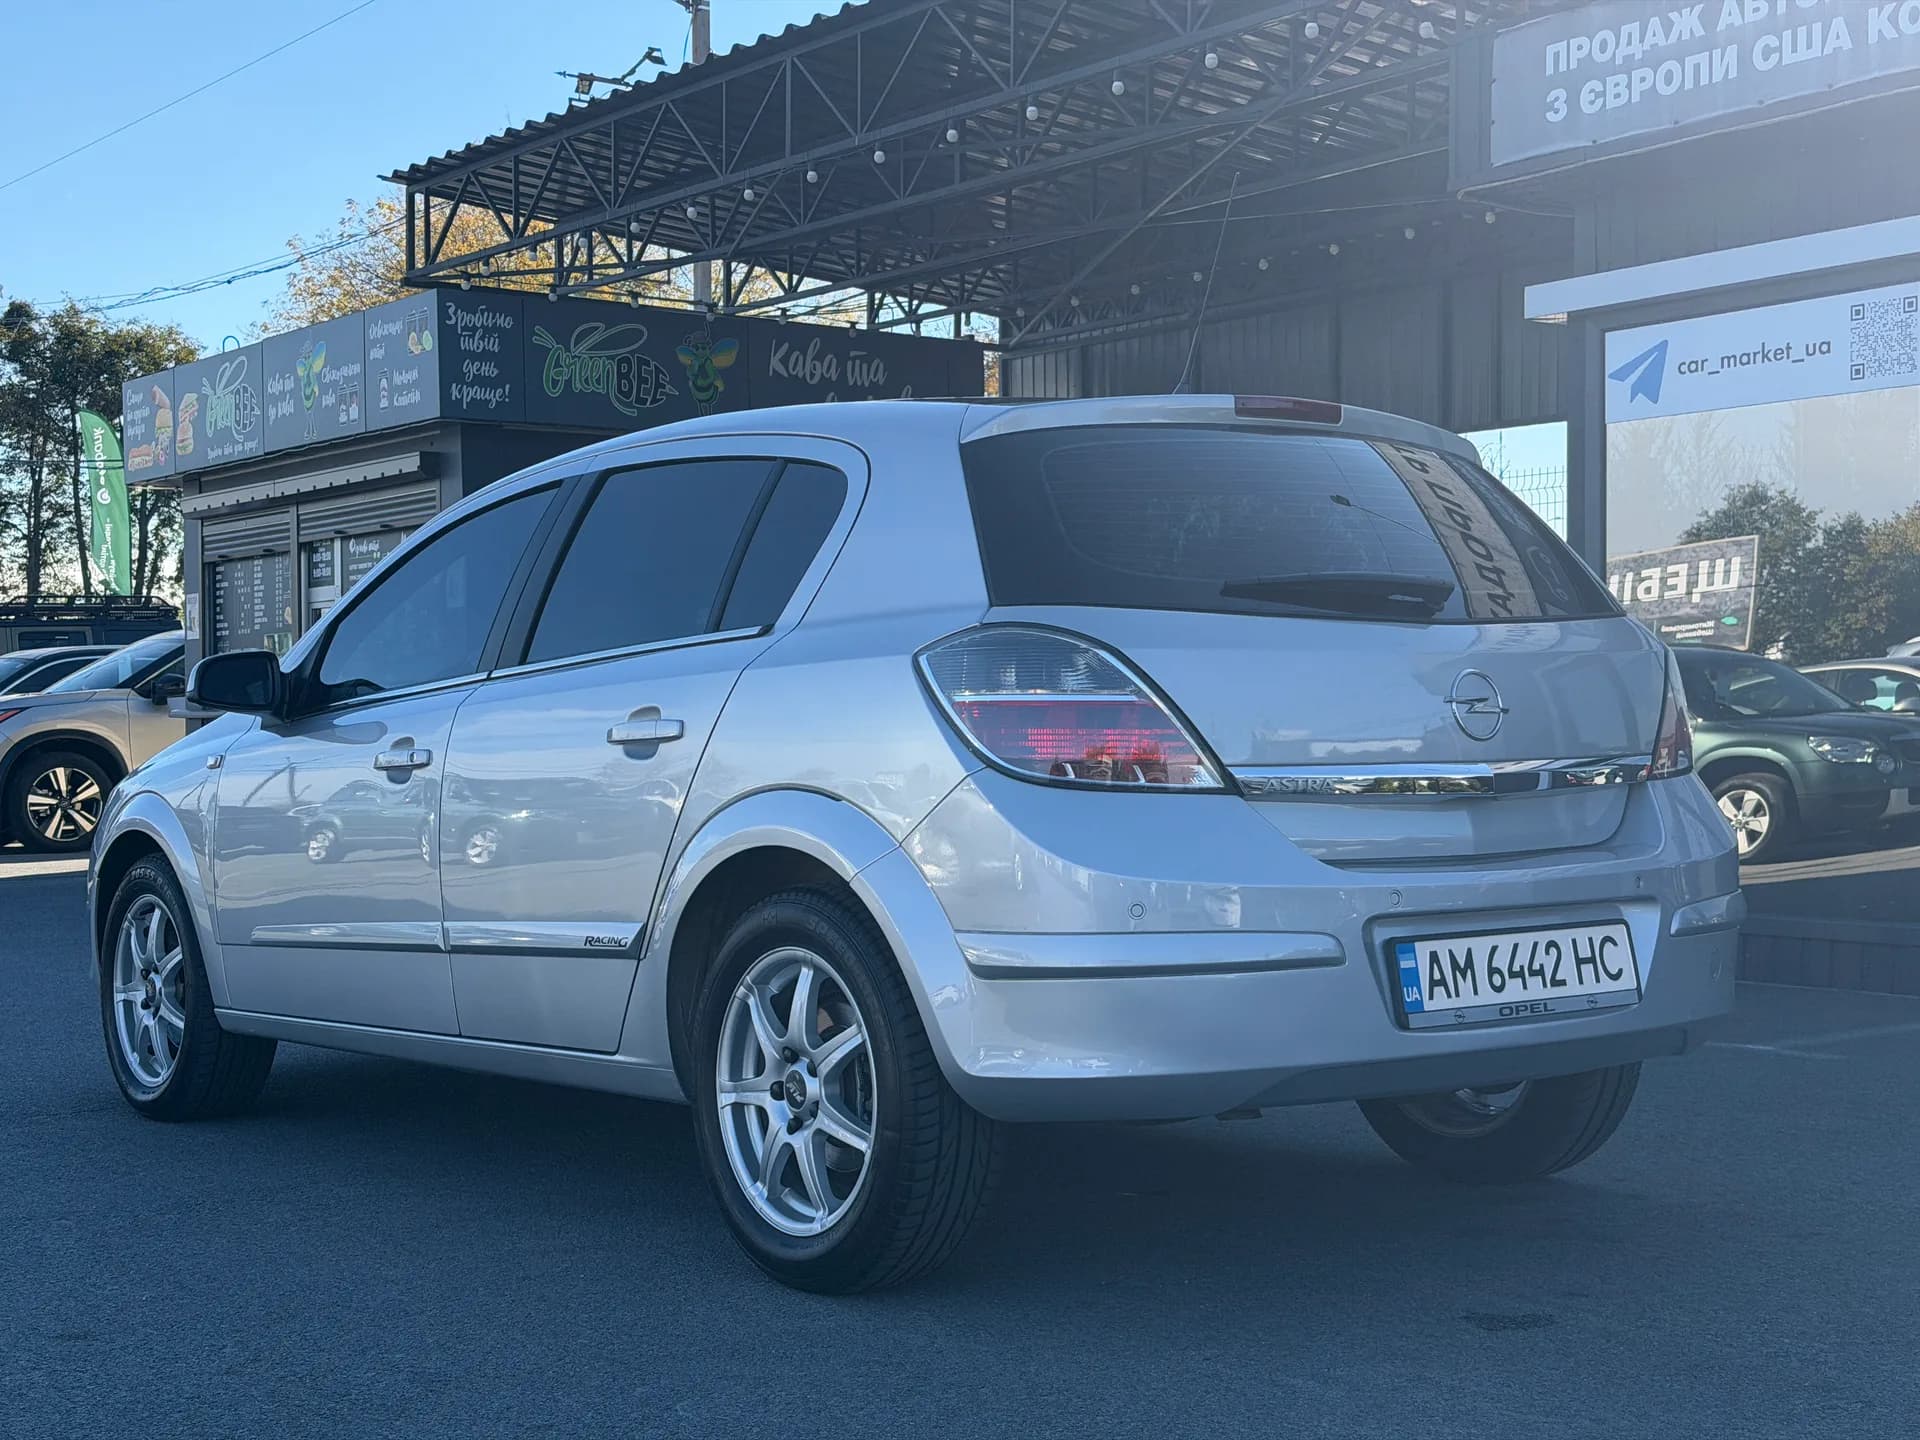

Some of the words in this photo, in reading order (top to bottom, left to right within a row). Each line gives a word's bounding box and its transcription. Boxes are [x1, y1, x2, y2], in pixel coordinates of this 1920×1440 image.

[1545, 3, 1706, 76] ПРОДАЖ
[1545, 88, 1568, 122] З
[1580, 44, 1738, 114] ЄВРОПИ
[1752, 16, 1853, 71] США
[445, 302, 514, 334] Зробимо
[460, 328, 501, 352] твій
[463, 359, 499, 382] день
[769, 337, 840, 384] Кава
[847, 350, 888, 387] та
[1677, 340, 1832, 375] car_market_ua
[1263, 777, 1334, 792] ASTRA
[1427, 946, 1479, 1001] AM
[1486, 939, 1568, 994] 6442
[1571, 935, 1624, 986] HC
[1404, 987, 1421, 1002] UA
[1499, 1002, 1556, 1017] OPEL
